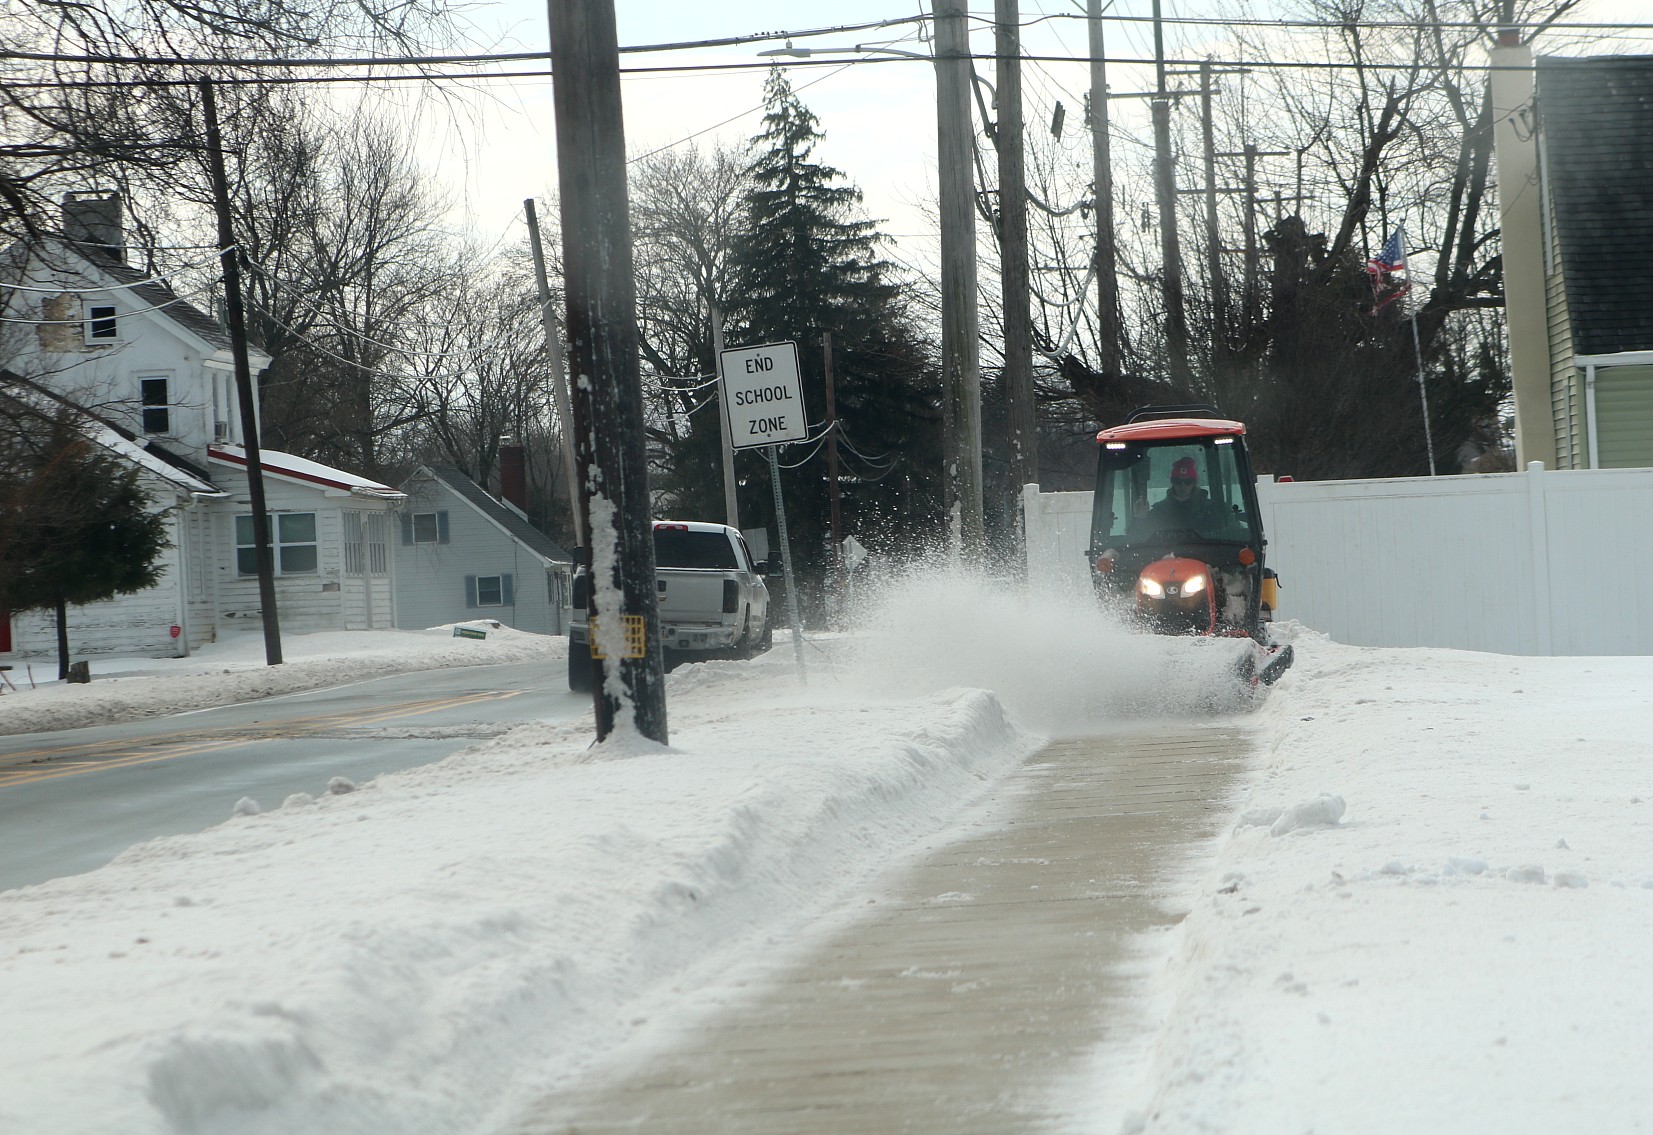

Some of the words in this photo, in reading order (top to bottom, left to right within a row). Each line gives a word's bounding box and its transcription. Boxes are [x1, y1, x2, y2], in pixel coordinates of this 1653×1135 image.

[745, 356, 774, 374] END
[735, 385, 793, 406] SCHOOL
[748, 415, 788, 435] ZONE
